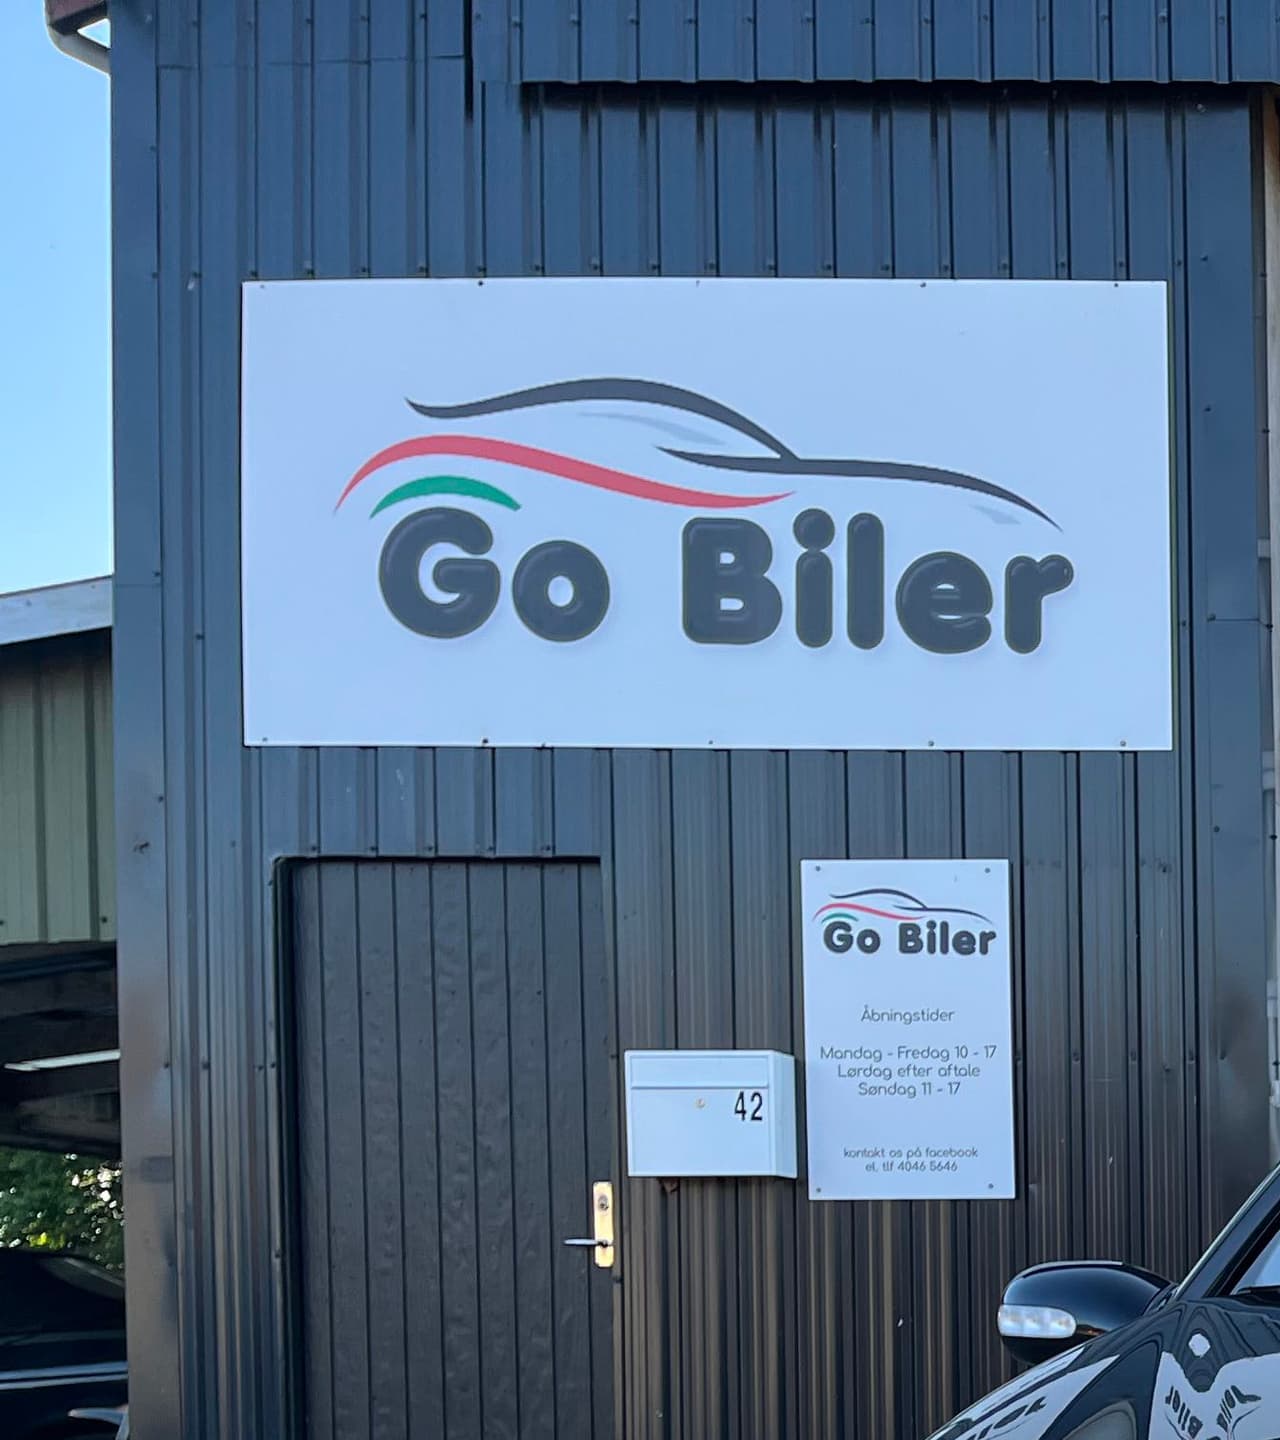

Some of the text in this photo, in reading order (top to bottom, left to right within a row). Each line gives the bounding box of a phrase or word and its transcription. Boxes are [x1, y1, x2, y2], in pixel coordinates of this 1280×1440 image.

[378, 507, 1075, 655] Go Biler
[823, 920, 997, 955] Go Biler
[860, 1004, 956, 1025] Åbningstider
[820, 1046, 883, 1063] Mandag
[897, 1045, 950, 1062] Fredag
[954, 1045, 969, 1059] 10
[984, 1044, 997, 1059] 17
[837, 1063, 981, 1081] Lørdag efter aftale
[858, 1081, 917, 1099] Søndag
[921, 1081, 932, 1095] 11
[948, 1081, 961, 1095] 17
[734, 1090, 763, 1121] 42
[843, 1146, 978, 1160] kontakt os på facebook
[897, 1161, 926, 1172] 4046
[929, 1161, 958, 1172] 5646
